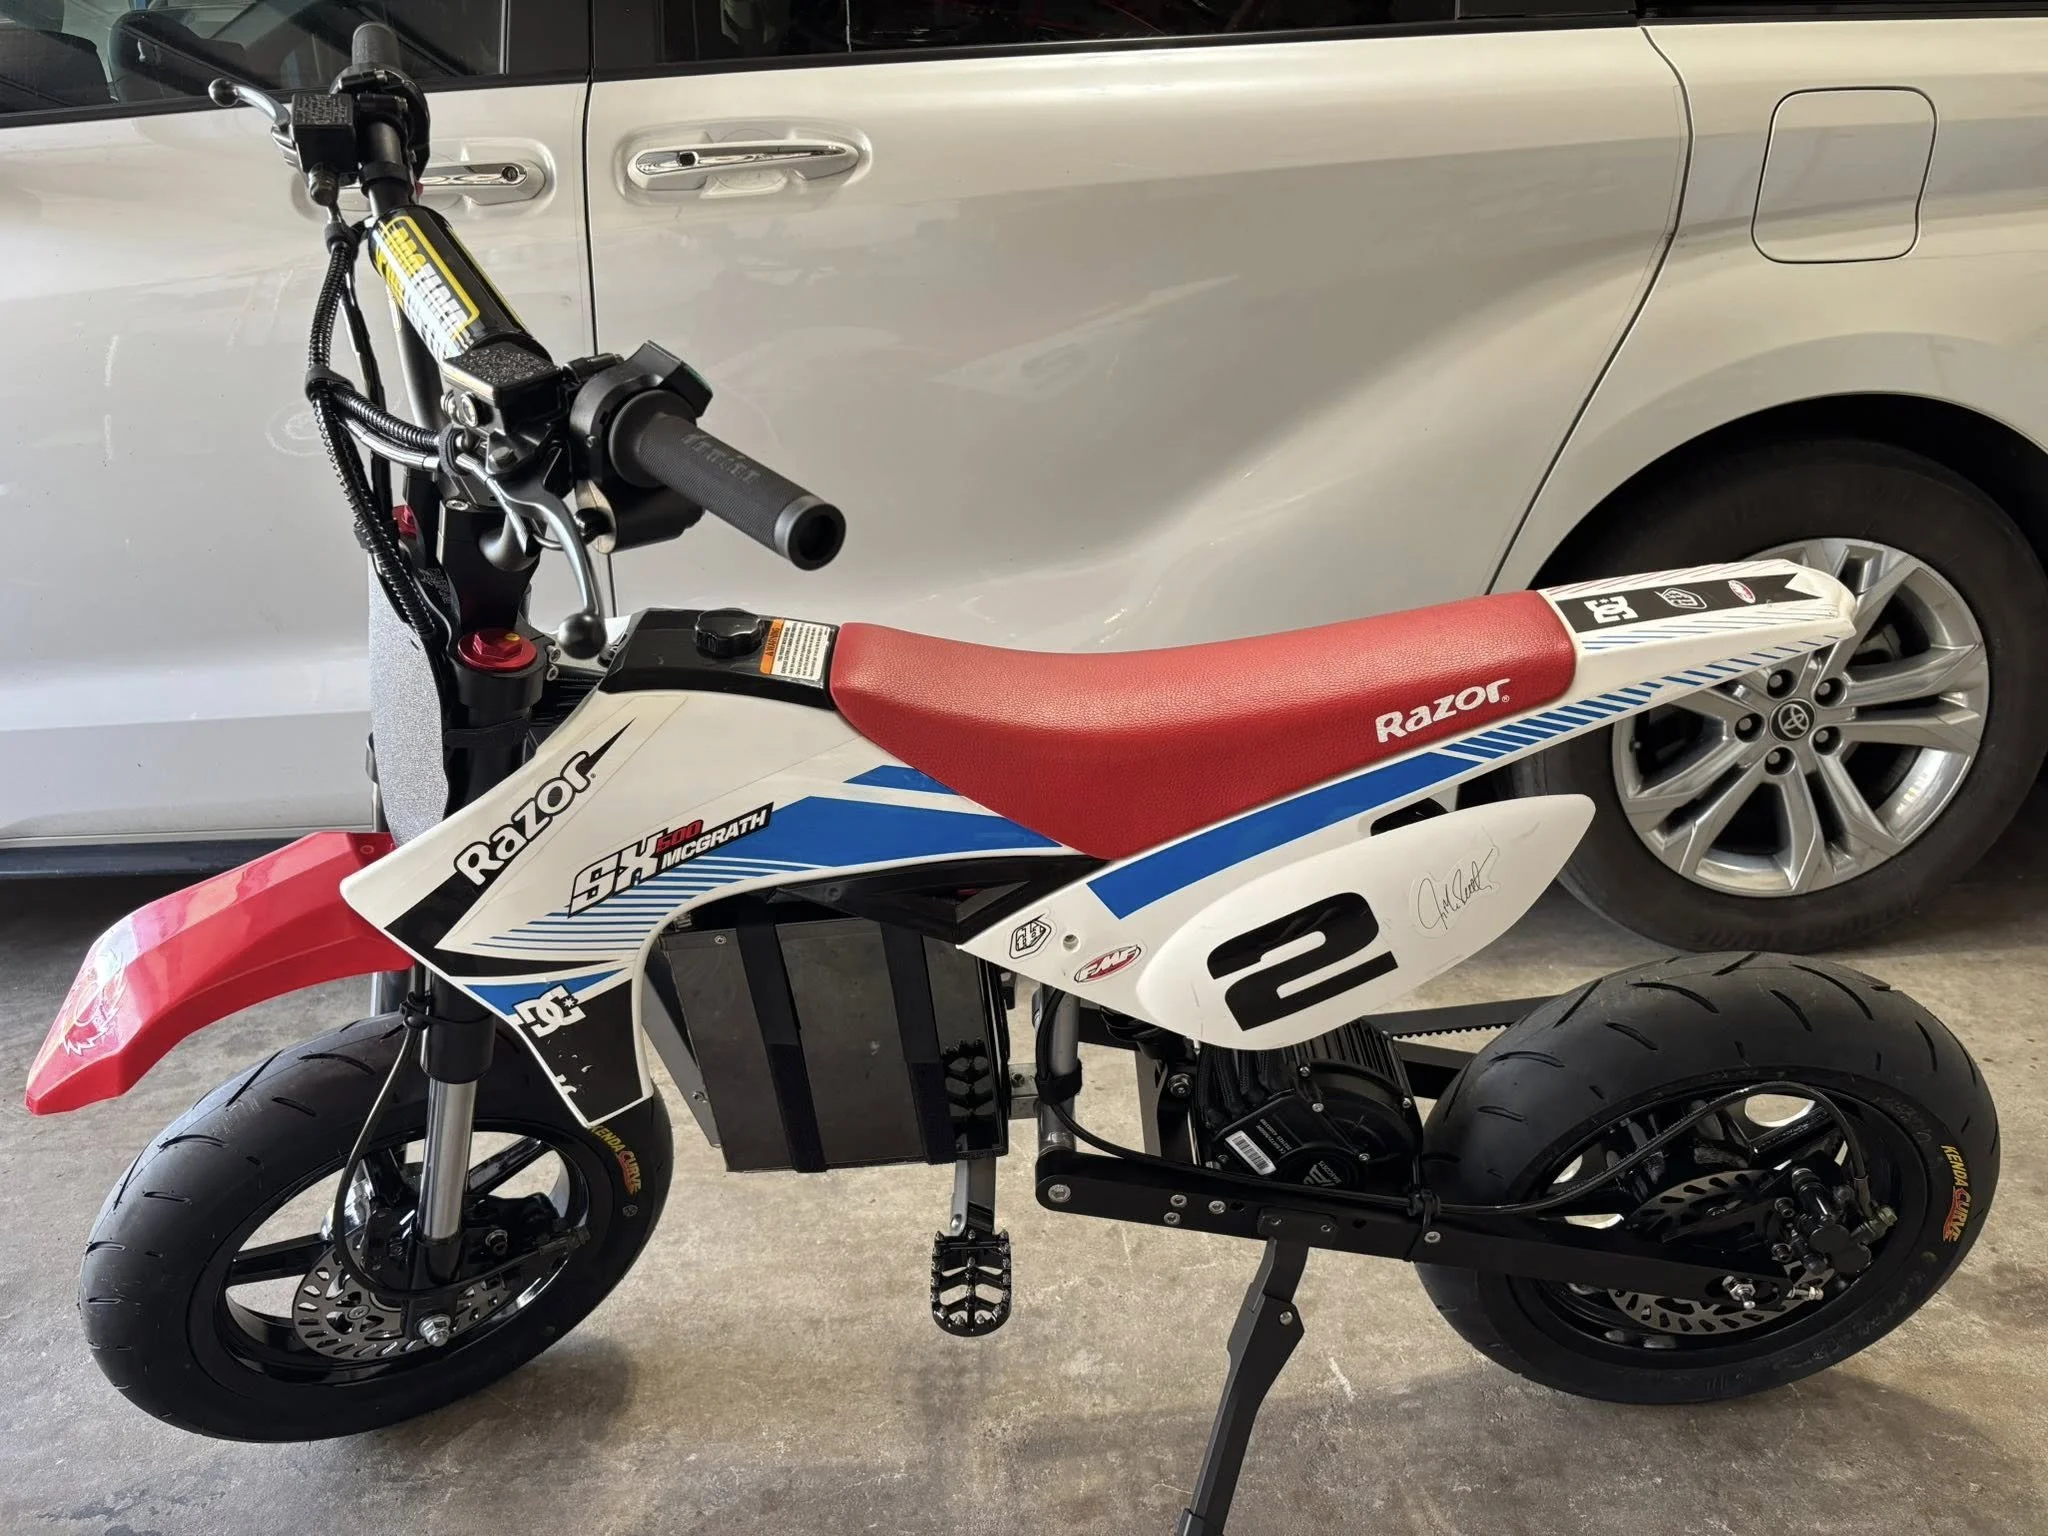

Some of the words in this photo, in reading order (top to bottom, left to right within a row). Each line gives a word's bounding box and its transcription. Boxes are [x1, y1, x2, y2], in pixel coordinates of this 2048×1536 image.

[766, 627, 781, 653] WARNING
[1375, 678, 1511, 743] Razor
[453, 747, 597, 886] Razor
[568, 827, 668, 918] SX
[656, 820, 704, 853] 500
[1078, 944, 1140, 982] FMF
[1207, 892, 1398, 1031] 2
[513, 985, 587, 1038] DC
[1941, 1144, 1969, 1187] KENDA
